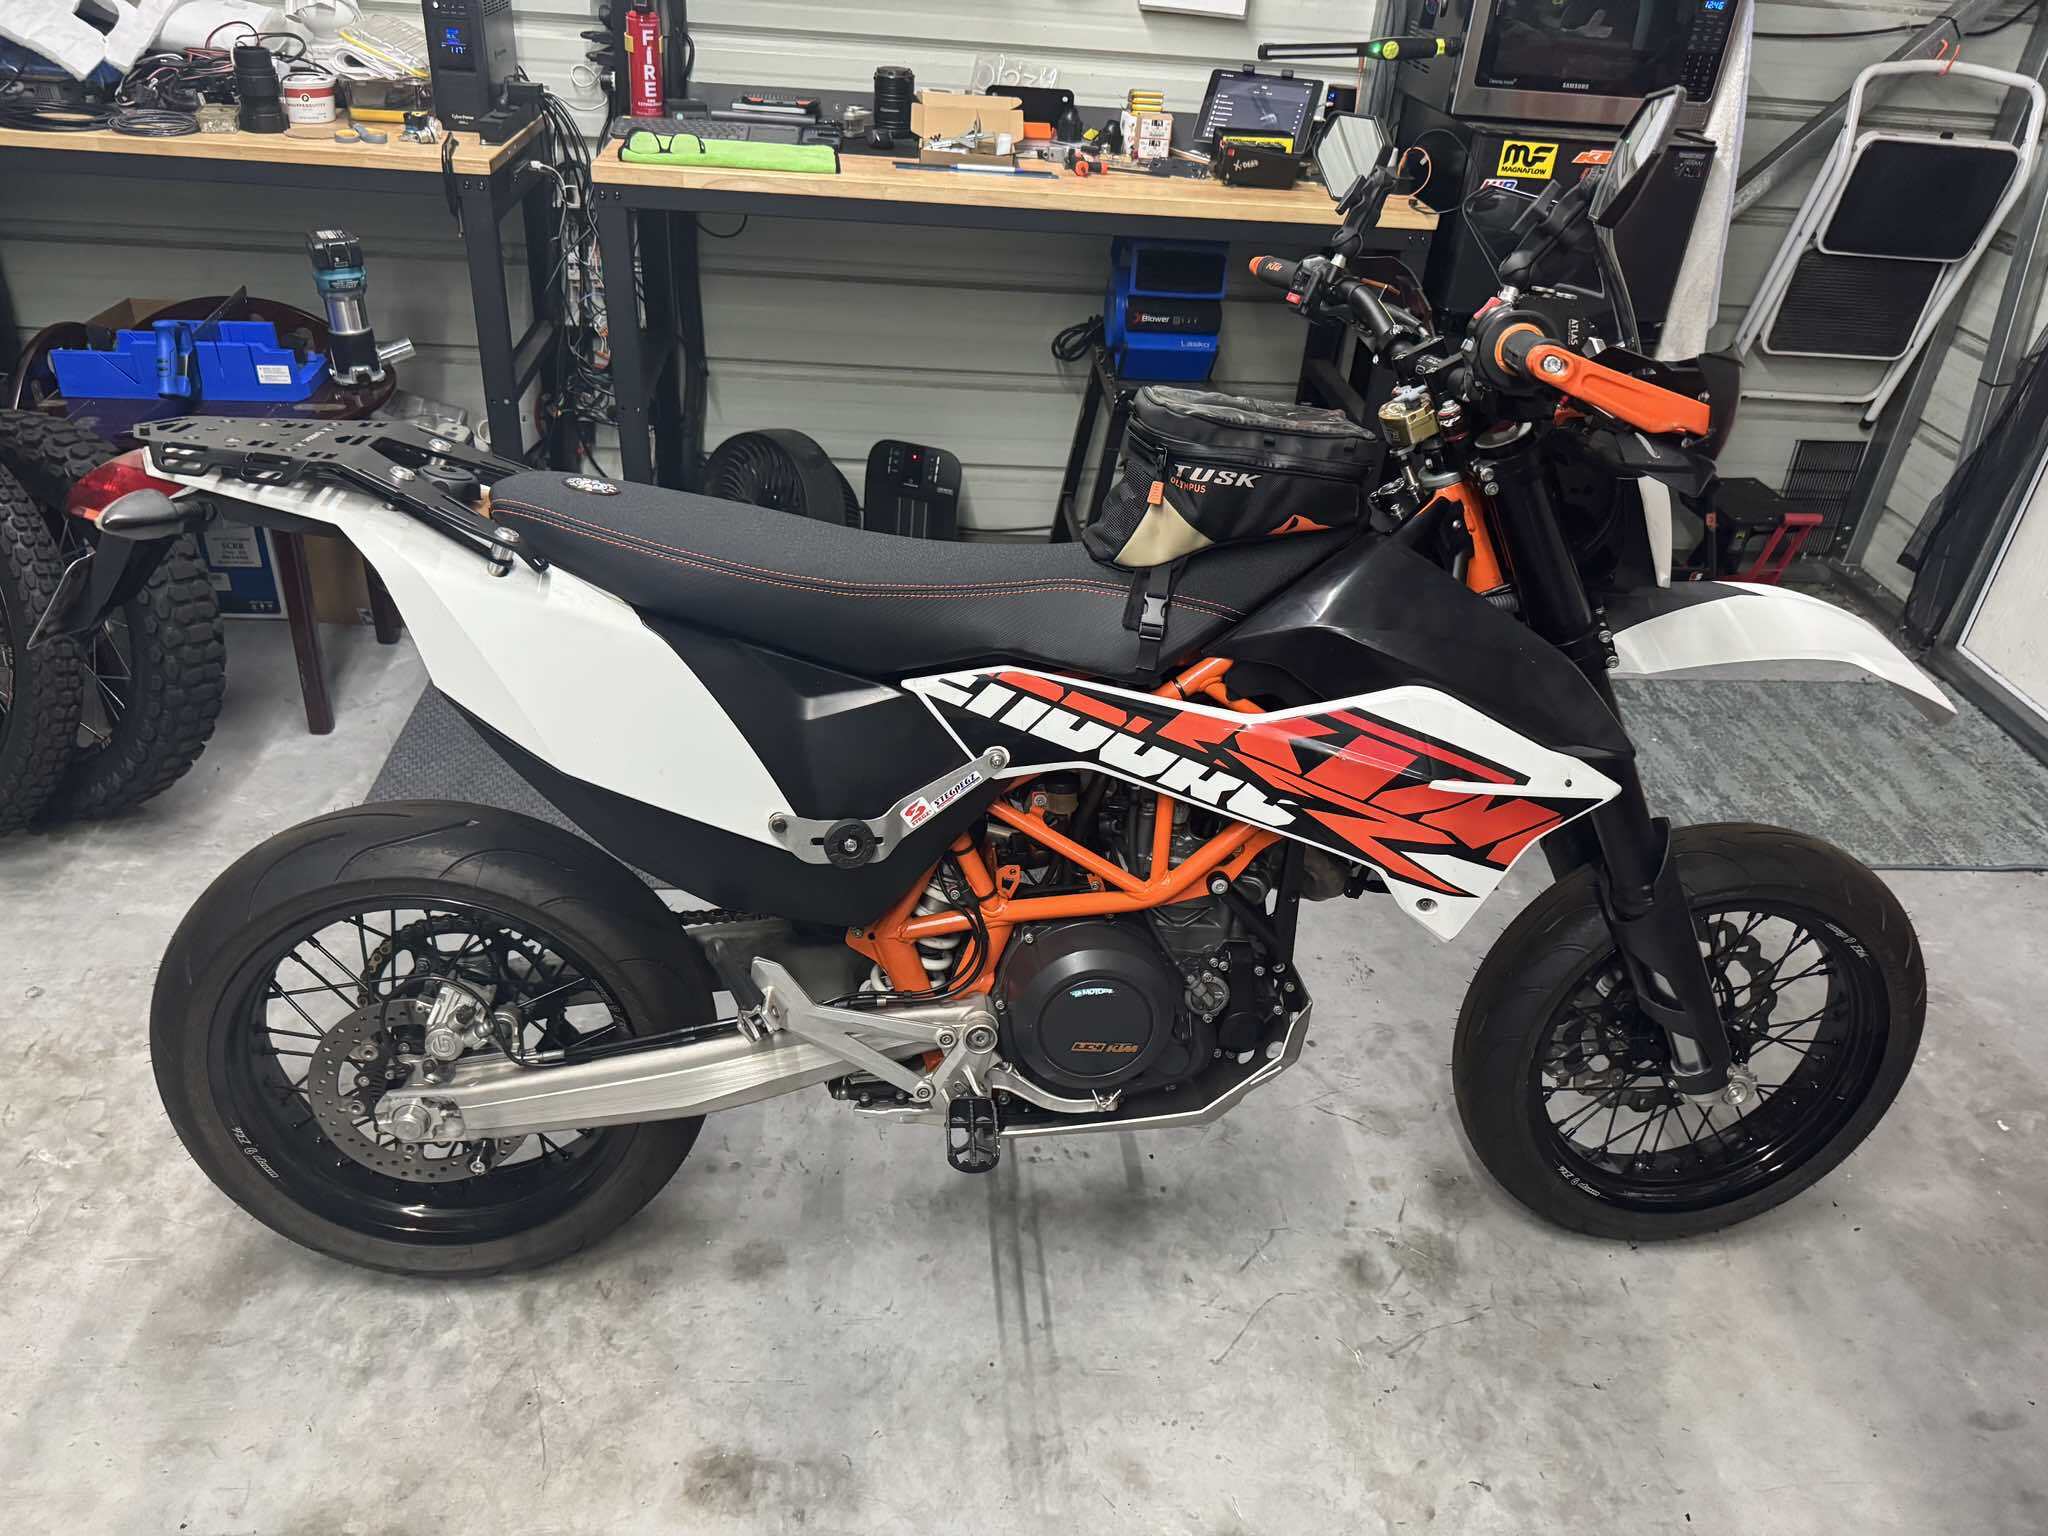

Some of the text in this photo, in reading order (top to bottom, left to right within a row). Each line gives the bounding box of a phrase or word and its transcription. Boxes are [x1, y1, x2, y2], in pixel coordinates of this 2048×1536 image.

[642, 29, 657, 97] FIRE
[1501, 165, 1547, 175] MAGNAFLOW
[1571, 318, 1579, 346] ATLAS
[1170, 476, 1206, 494] OLYMPUS
[1174, 463, 1262, 489] TUSK
